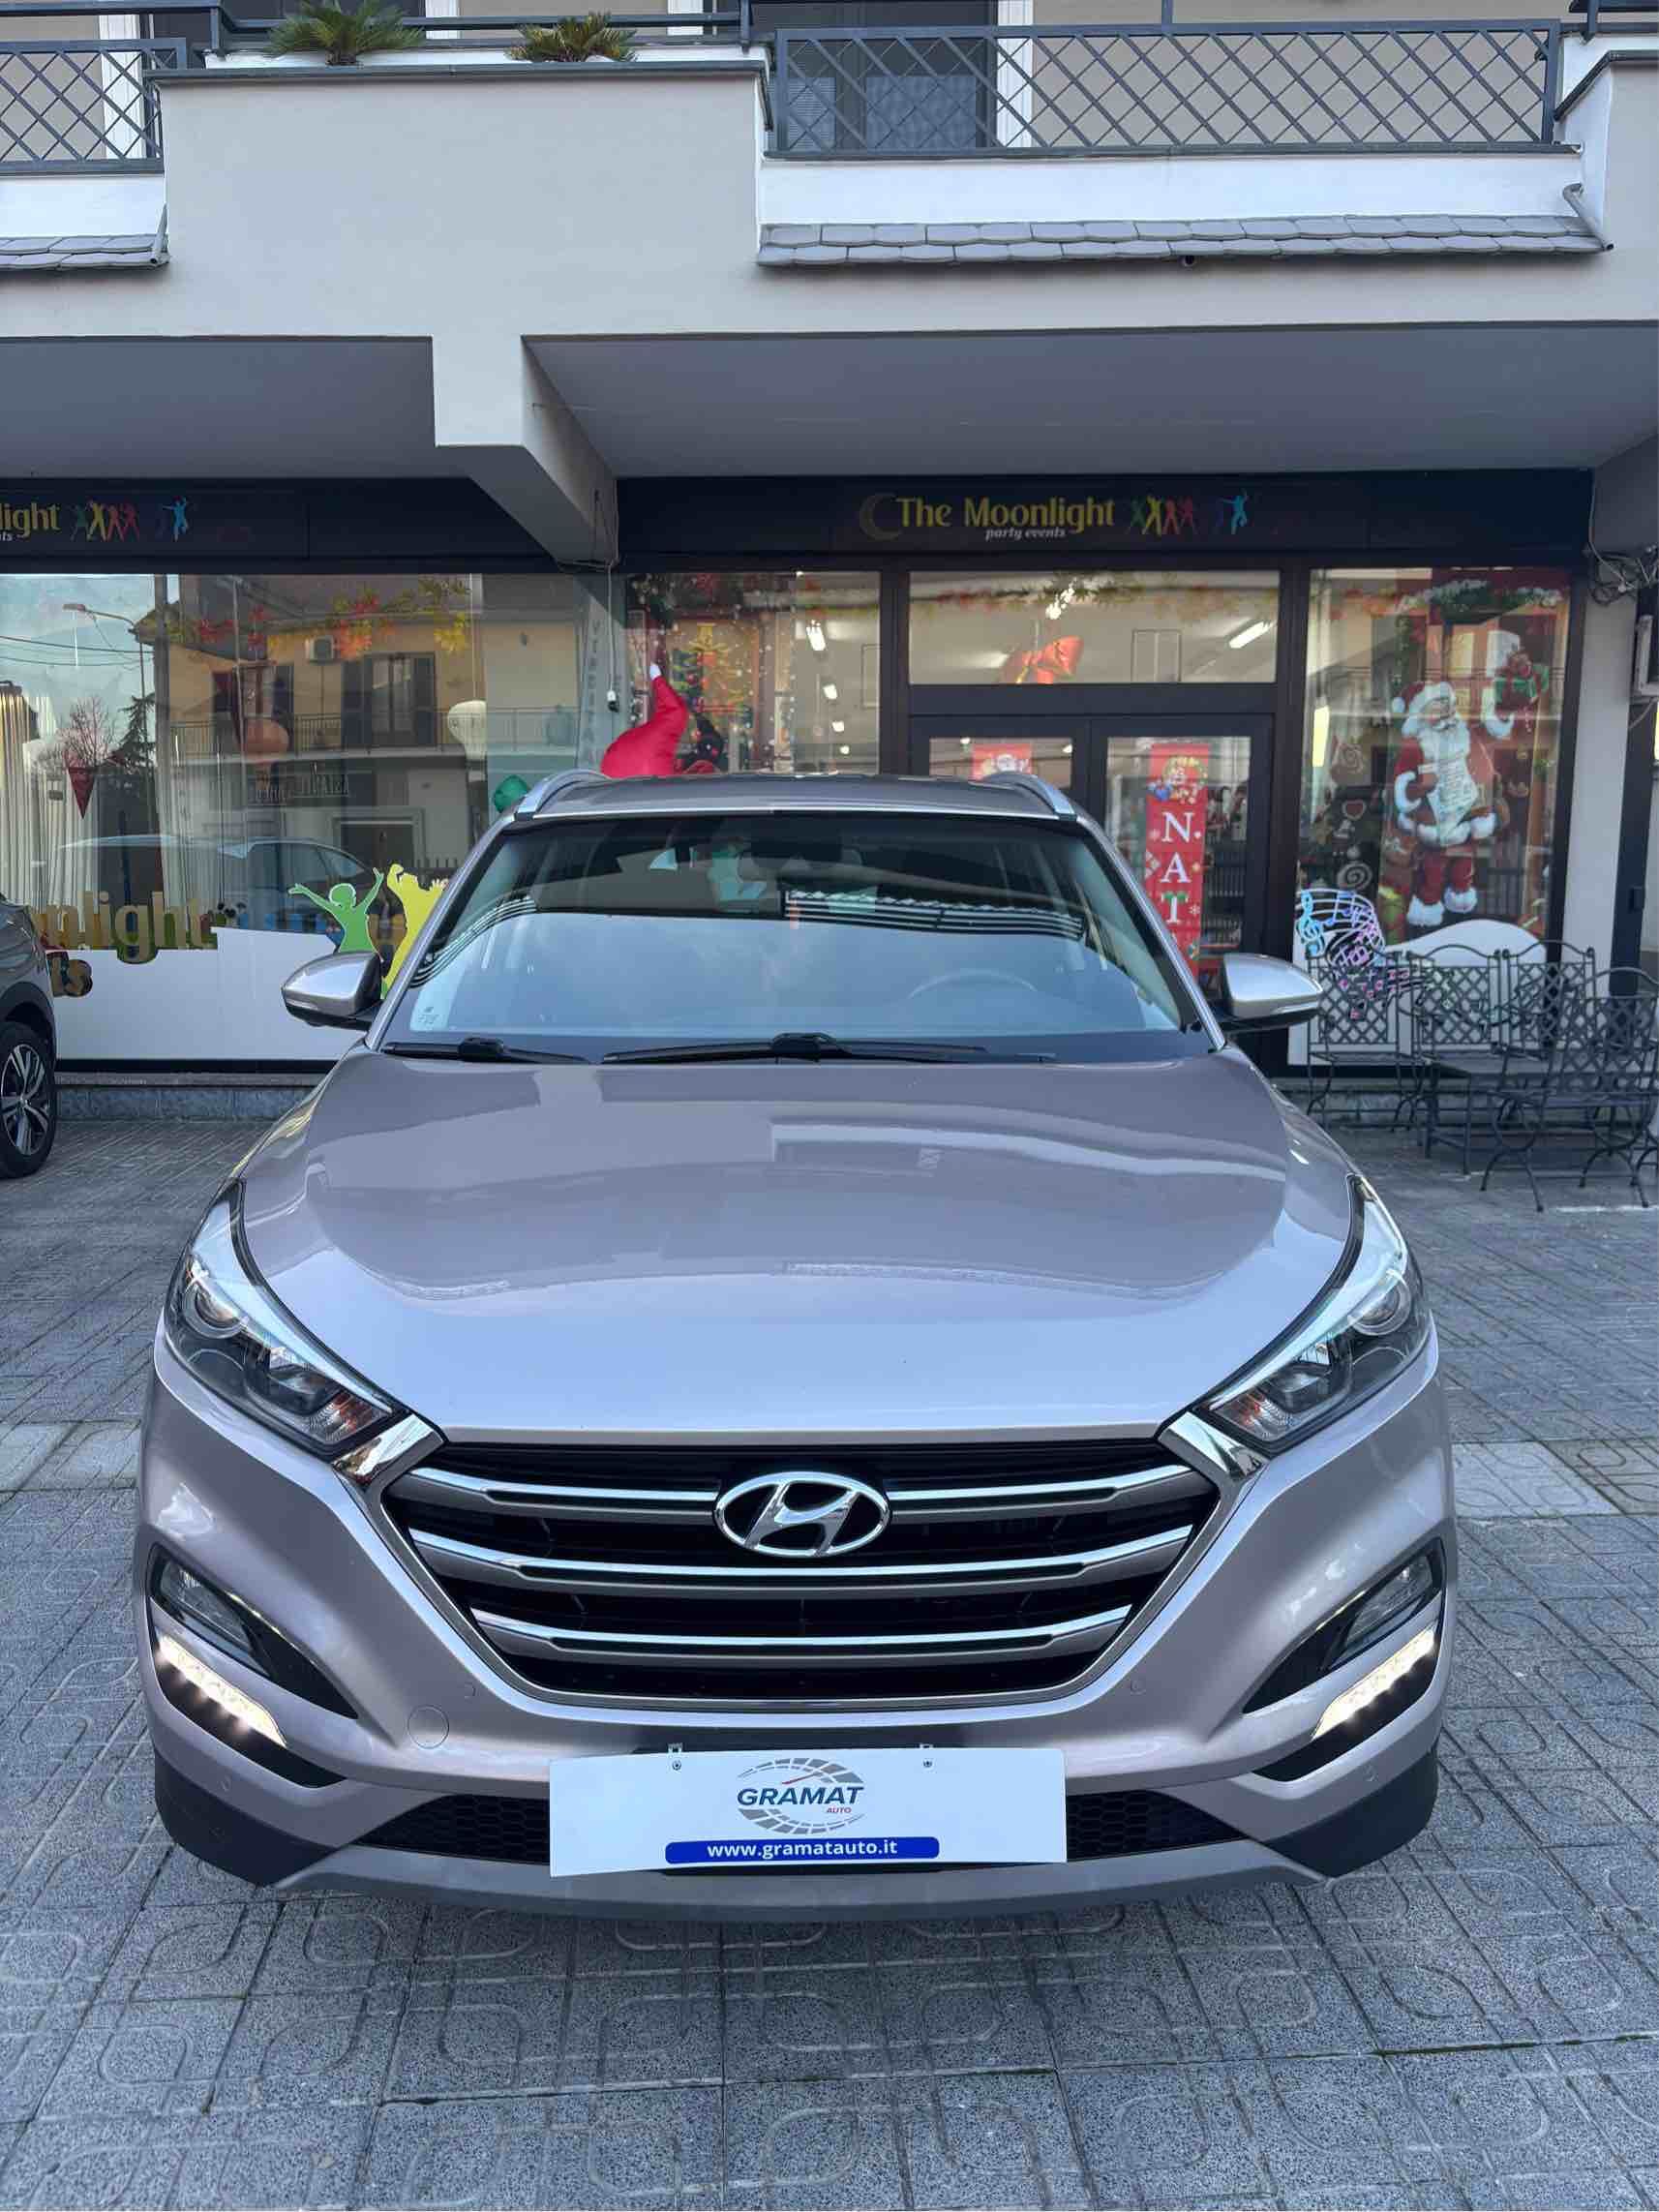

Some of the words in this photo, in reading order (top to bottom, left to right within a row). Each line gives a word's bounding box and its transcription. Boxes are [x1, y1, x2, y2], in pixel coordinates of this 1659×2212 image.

[896, 498, 951, 528] The
[964, 497, 1116, 533] Moonlight
[984, 527, 1023, 542] party
[1025, 528, 1066, 539] events
[1160, 811, 1195, 941] NAT
[737, 1786, 864, 1806] GRAMAT
[707, 1839, 898, 1860] www.gramatauto.it
